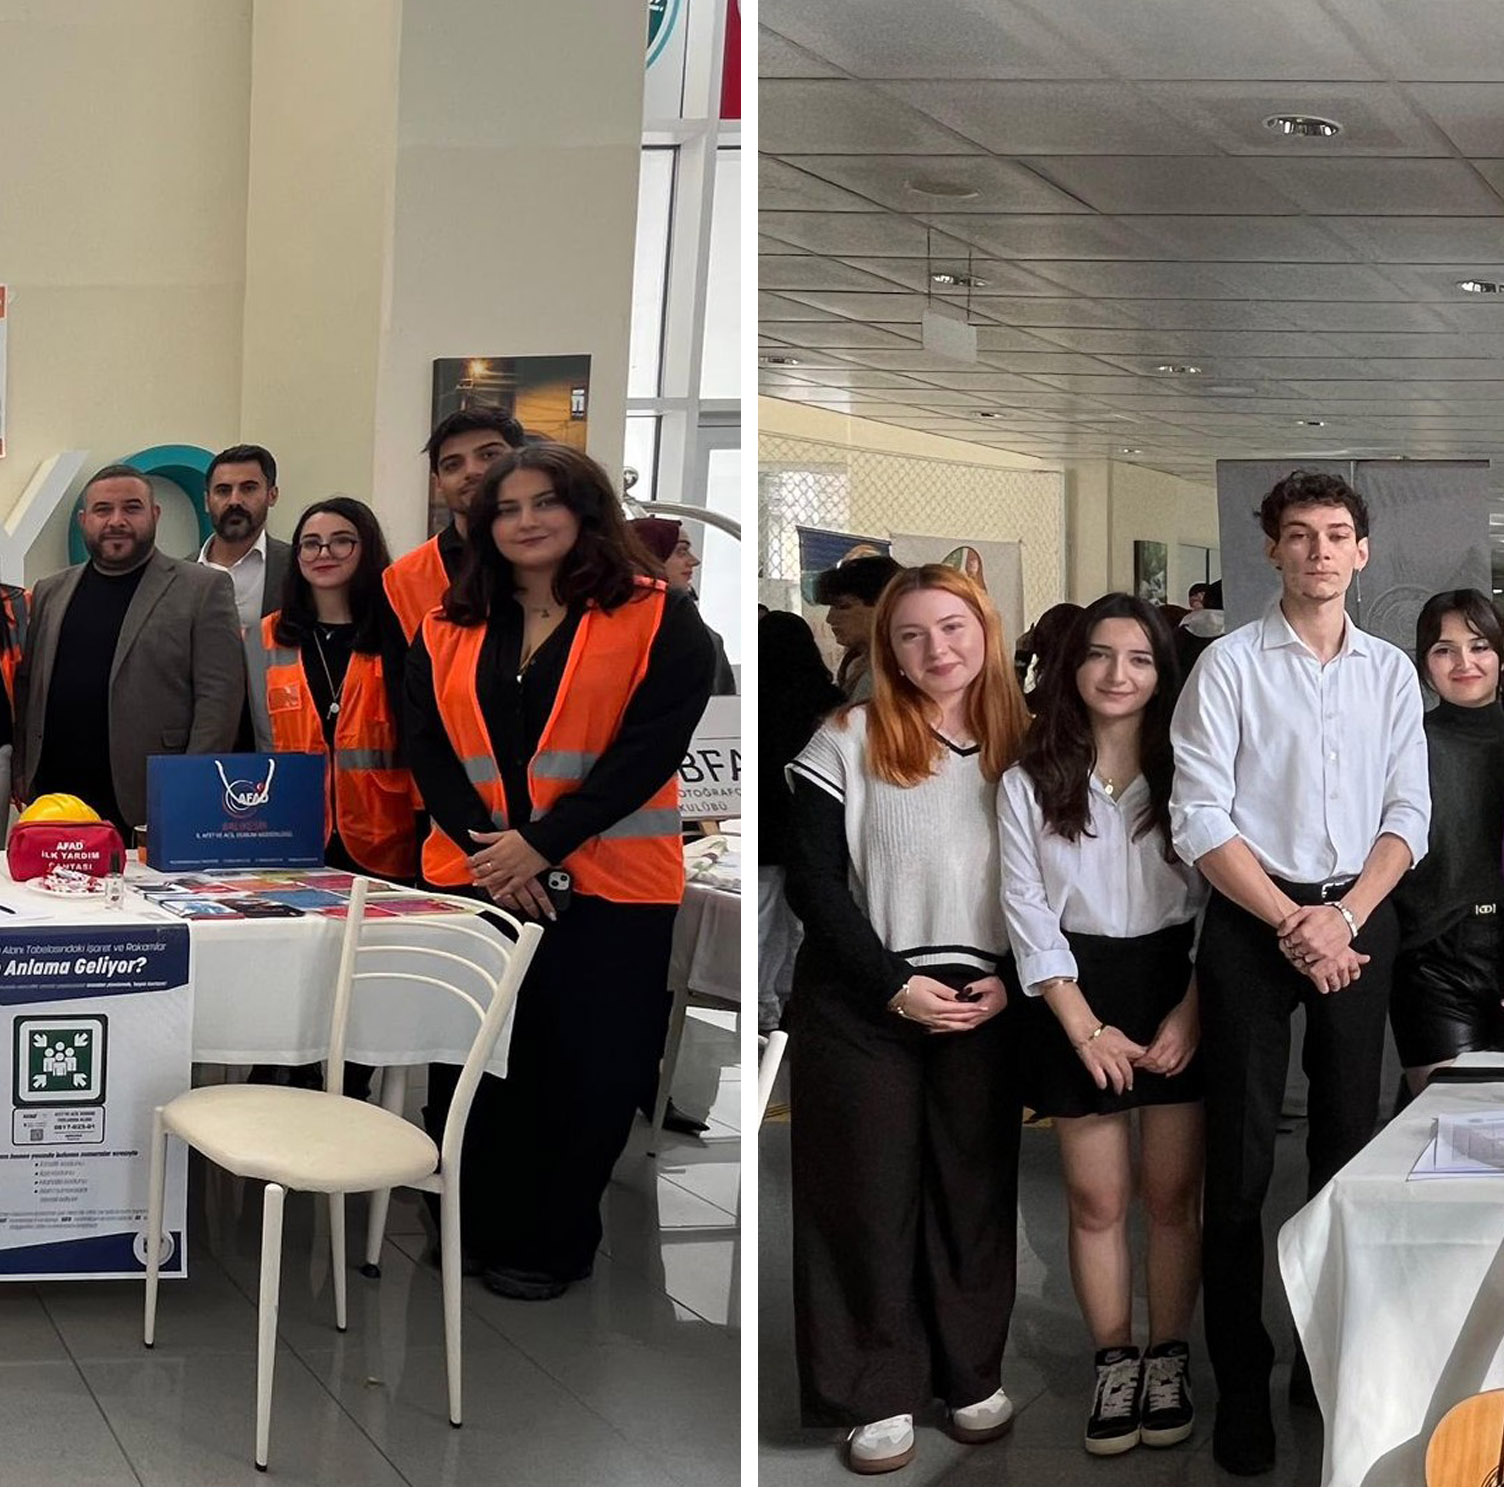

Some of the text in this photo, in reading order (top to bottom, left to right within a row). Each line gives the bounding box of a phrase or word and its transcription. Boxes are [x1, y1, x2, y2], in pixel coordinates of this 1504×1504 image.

[678, 749, 741, 782] BFA
[57, 842, 83, 850] AFAD
[4, 958, 69, 976] Anlama
[74, 957, 148, 977] Geliyor?
